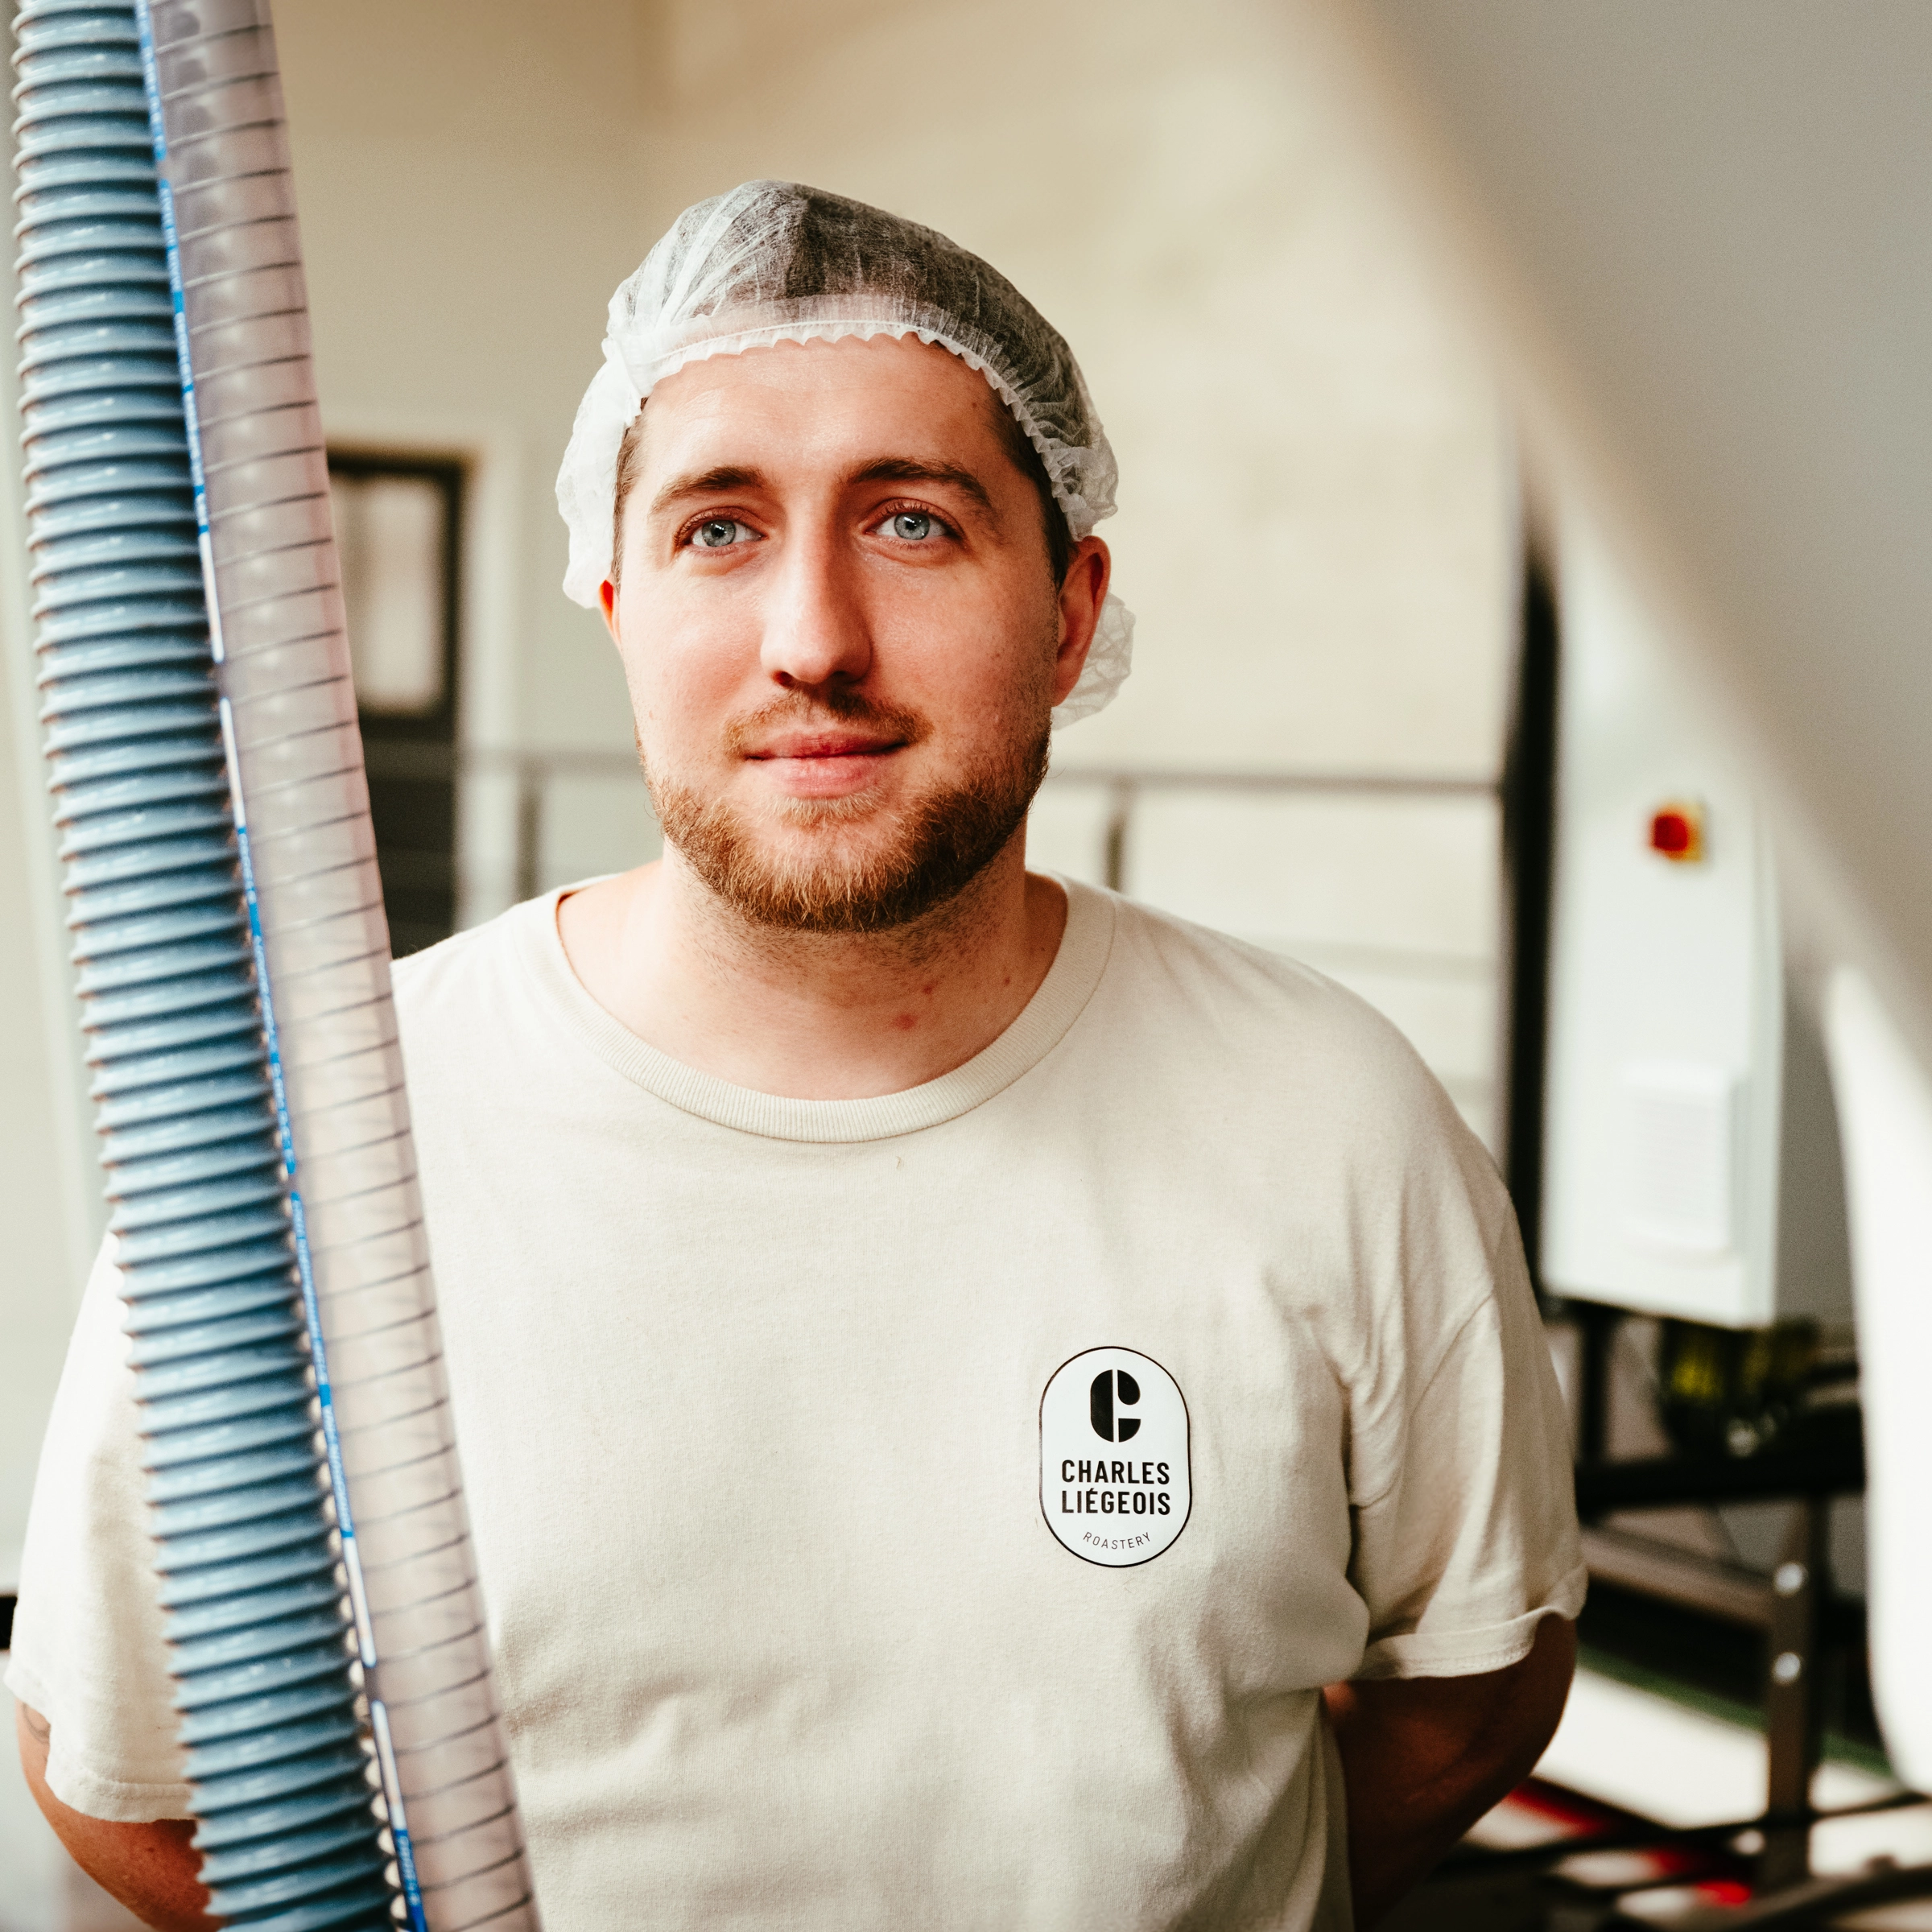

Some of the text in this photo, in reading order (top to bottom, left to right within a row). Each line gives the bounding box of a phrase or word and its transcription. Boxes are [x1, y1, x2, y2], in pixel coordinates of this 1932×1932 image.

[1061, 1459, 1171, 1485] CHARLES
[1061, 1487, 1171, 1516] LIÉGEOIS
[1083, 1531, 1152, 1550] ROASTERY
